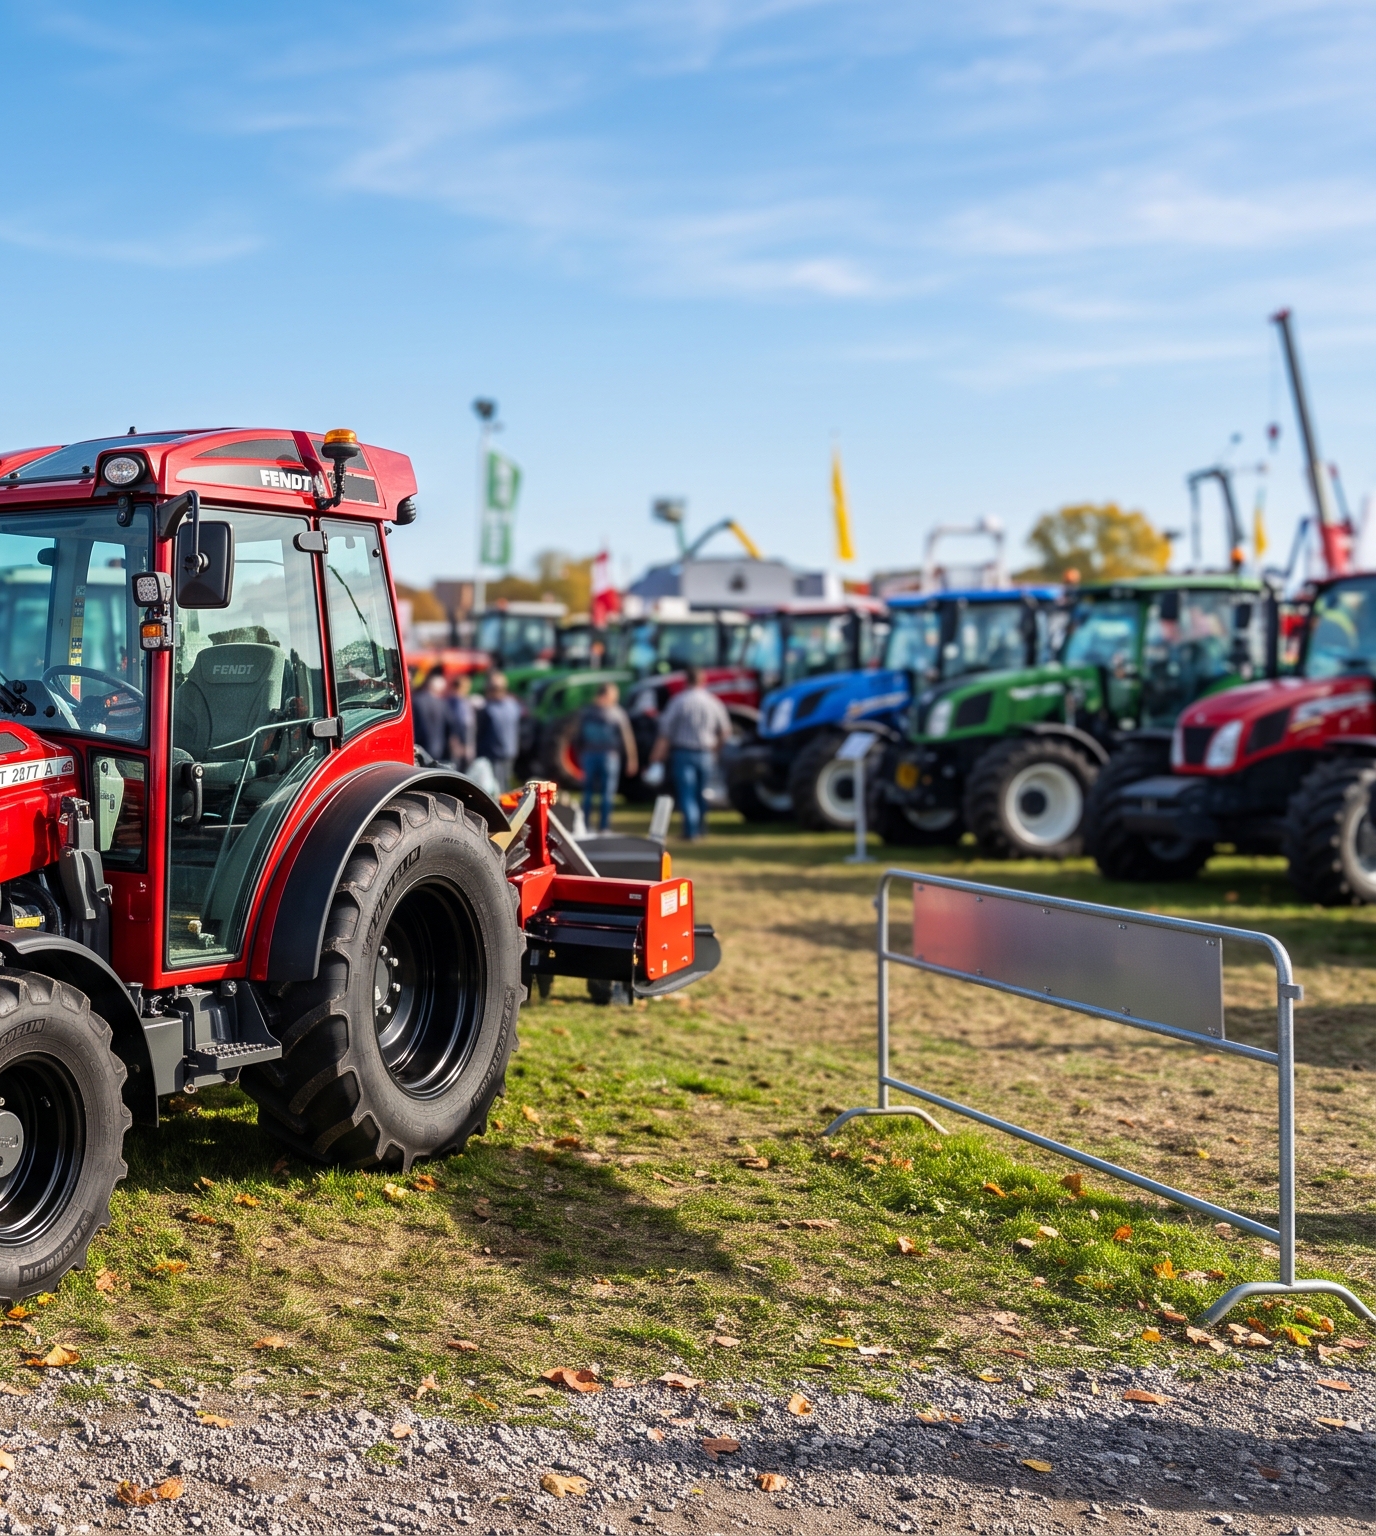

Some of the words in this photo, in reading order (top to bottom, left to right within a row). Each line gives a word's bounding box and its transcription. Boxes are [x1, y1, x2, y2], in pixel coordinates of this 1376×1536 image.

[259, 469, 312, 492] FENDT
[212, 664, 255, 675] FENDT
[44, 762, 53, 776] A
